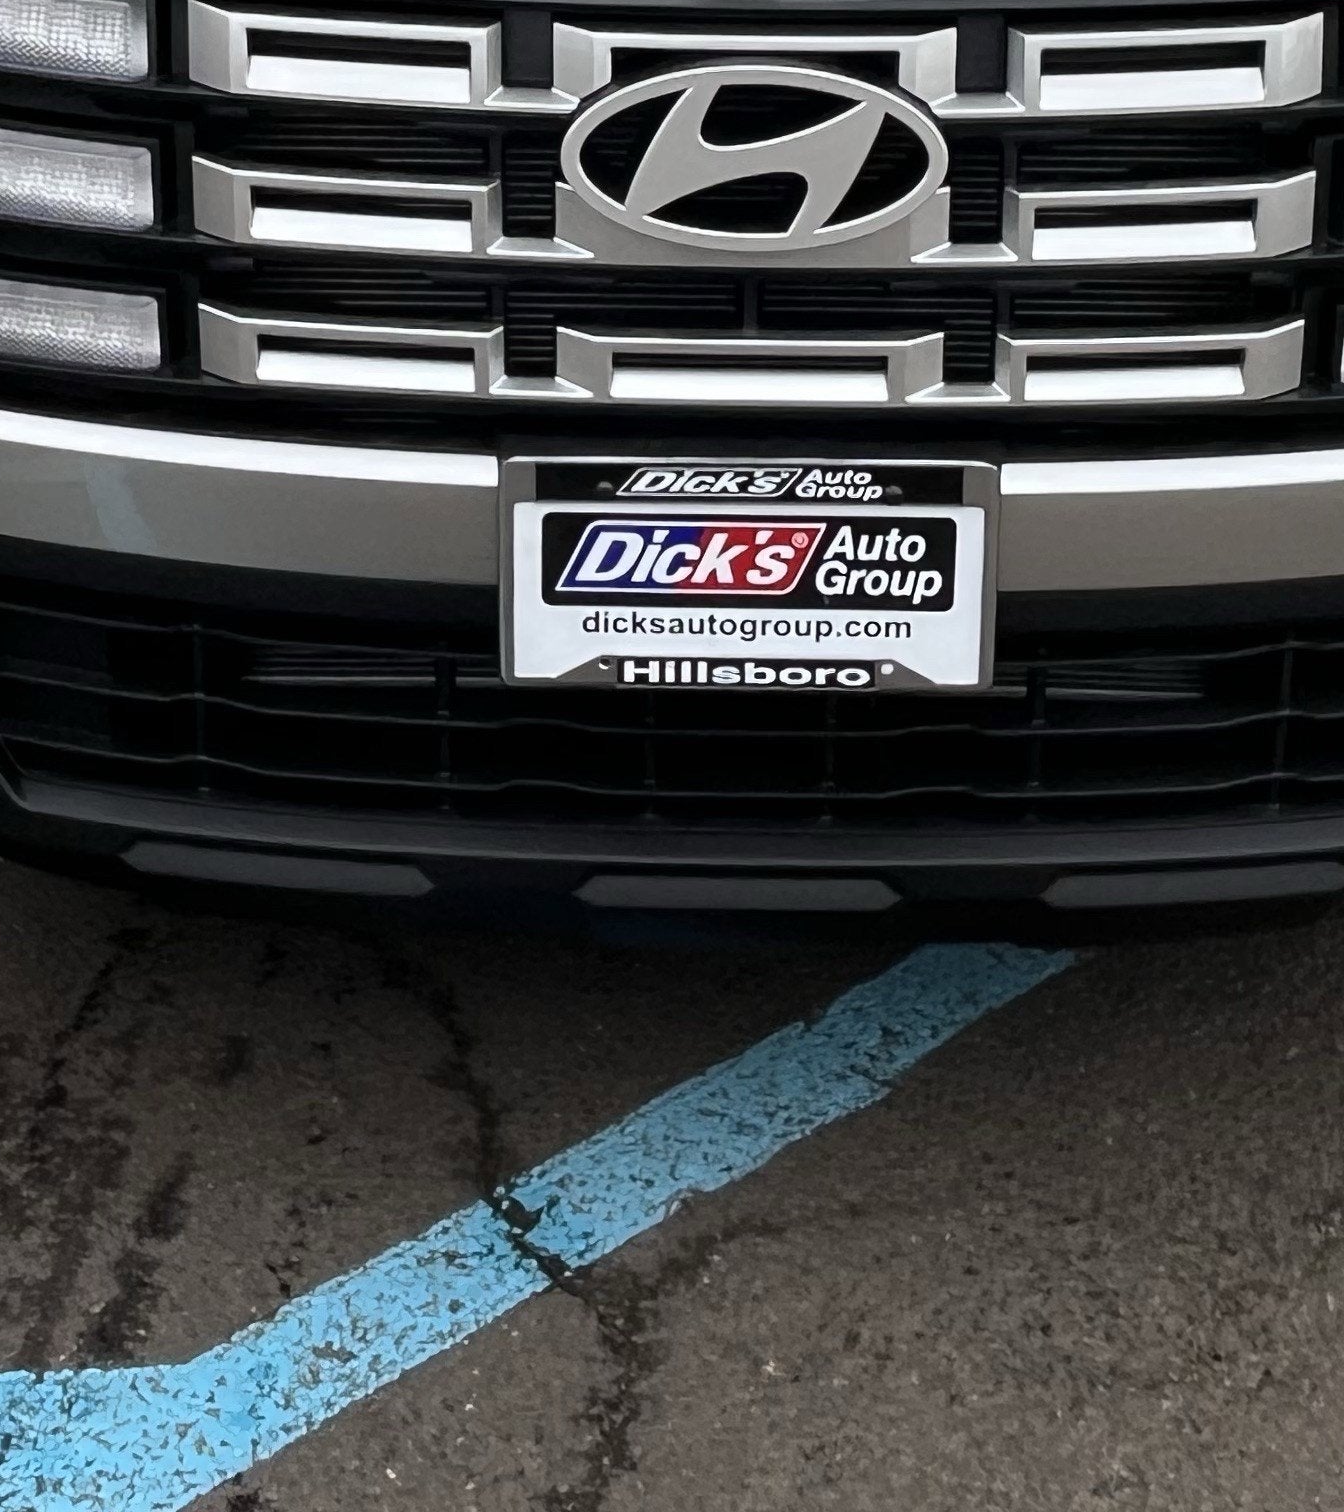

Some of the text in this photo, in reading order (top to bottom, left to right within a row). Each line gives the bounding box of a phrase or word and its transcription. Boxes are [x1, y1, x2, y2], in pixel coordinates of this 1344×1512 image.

[630, 469, 784, 494] Dick's
[800, 468, 872, 485] Auto
[795, 482, 883, 501] Group
[573, 529, 794, 585] Dick's
[823, 525, 927, 563] Auto
[815, 561, 943, 604] Group
[582, 611, 913, 642] dicksautogroup.com
[622, 660, 872, 687] Hillsboro
